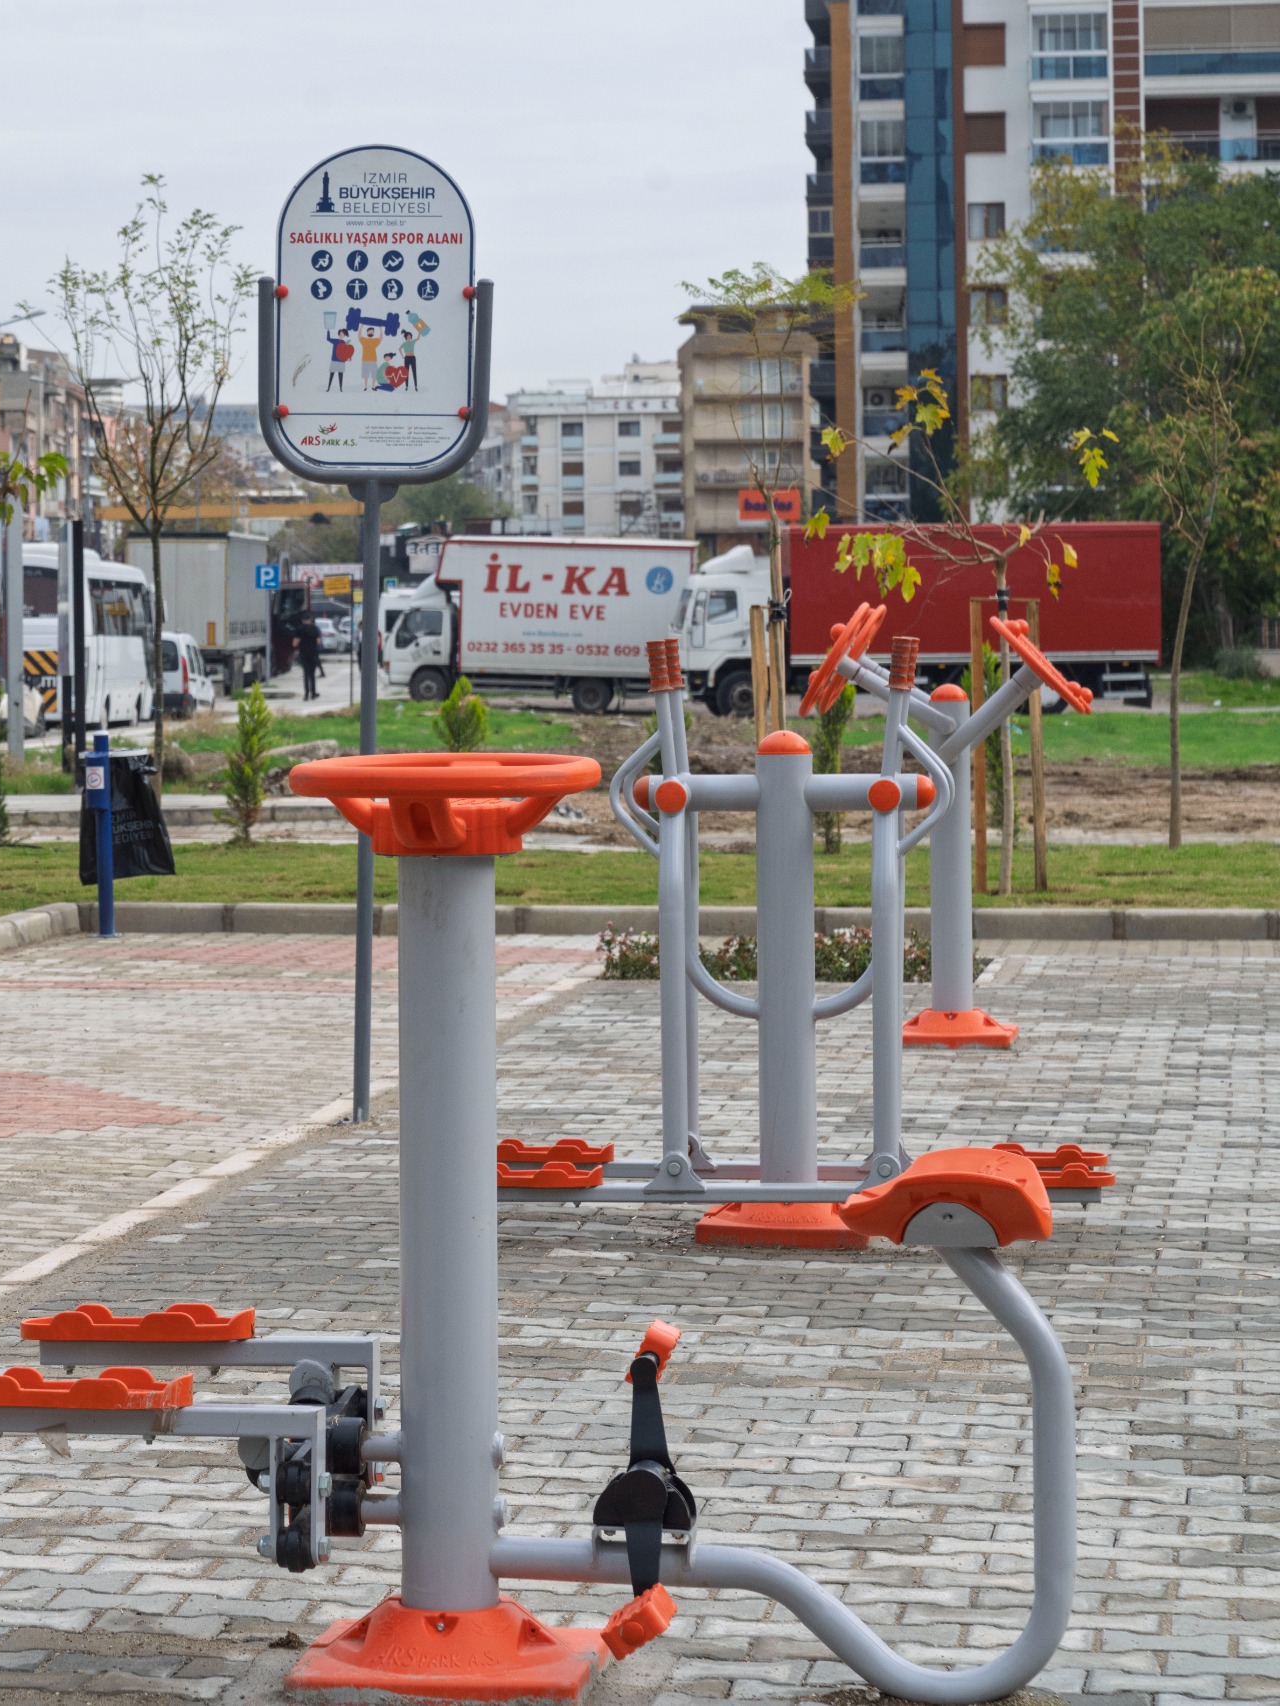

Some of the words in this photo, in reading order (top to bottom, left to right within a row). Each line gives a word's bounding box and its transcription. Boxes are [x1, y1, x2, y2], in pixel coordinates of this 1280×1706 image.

[363, 172, 407, 184] İZMİR
[339, 184, 435, 201] BÜYÜKŞEHİR
[343, 201, 431, 213] BELEDİYESİ
[290, 230, 343, 244] SAĞLIKLI
[346, 232, 388, 247] YAŞAM
[391, 232, 424, 244] SPOR
[426, 232, 463, 245] ALANI
[261, 567, 275, 587] P
[499, 602, 559, 619] EVDEN
[569, 604, 606, 621] EVE
[467, 641, 498, 654] 0232
[501, 642, 526, 655] 365
[529, 642, 545, 655] 35
[548, 643, 564, 656] 35
[575, 643, 610, 657] 0532
[613, 645, 641, 658] 609
